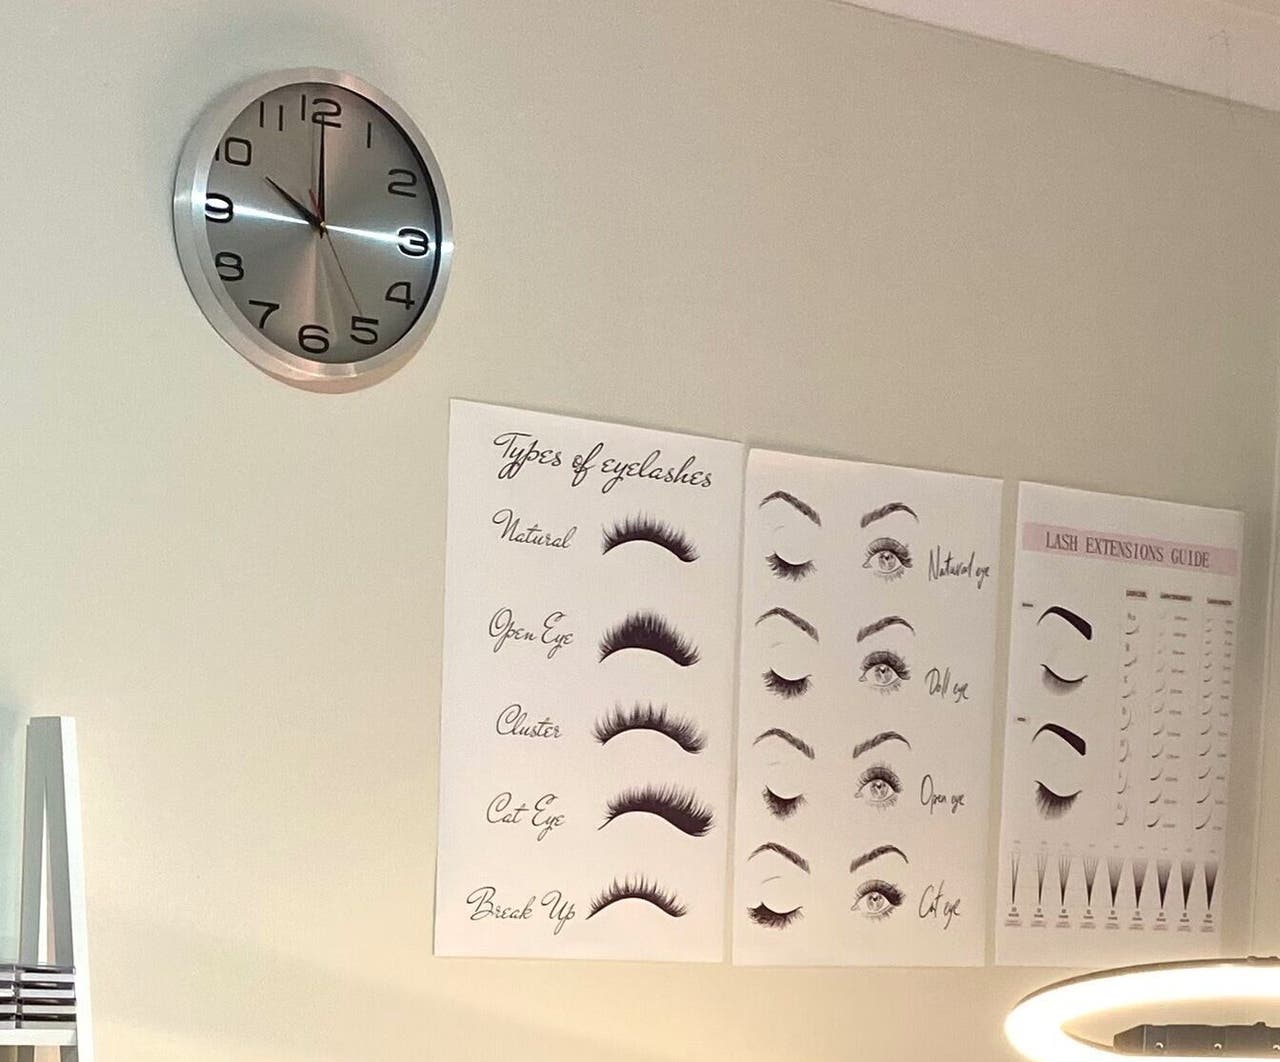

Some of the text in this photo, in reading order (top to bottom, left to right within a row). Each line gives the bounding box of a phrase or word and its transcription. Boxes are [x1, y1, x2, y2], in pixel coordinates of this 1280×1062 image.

[259, 100, 284, 131] 11
[301, 94, 342, 128] 12
[388, 168, 417, 198] 2
[205, 192, 234, 224] 9
[397, 227, 430, 257] 3
[215, 252, 245, 282] 8
[385, 281, 415, 310] 4
[249, 300, 280, 329] 7
[349, 315, 379, 345] 5
[298, 325, 330, 354] 6
[494, 431, 713, 495] Types of eyelashes
[492, 508, 577, 550] Natural
[1045, 531, 1210, 568] LASH EXTENSIONS GUIDE
[928, 550, 992, 590] Natural eye
[488, 607, 574, 659] Open Eye
[925, 667, 970, 701] Doll eye
[496, 703, 562, 740] Cluster
[920, 774, 965, 813] Open eye
[486, 791, 566, 841] Cat Eye
[466, 885, 576, 936] Break Up
[919, 880, 962, 930] Cat eye
